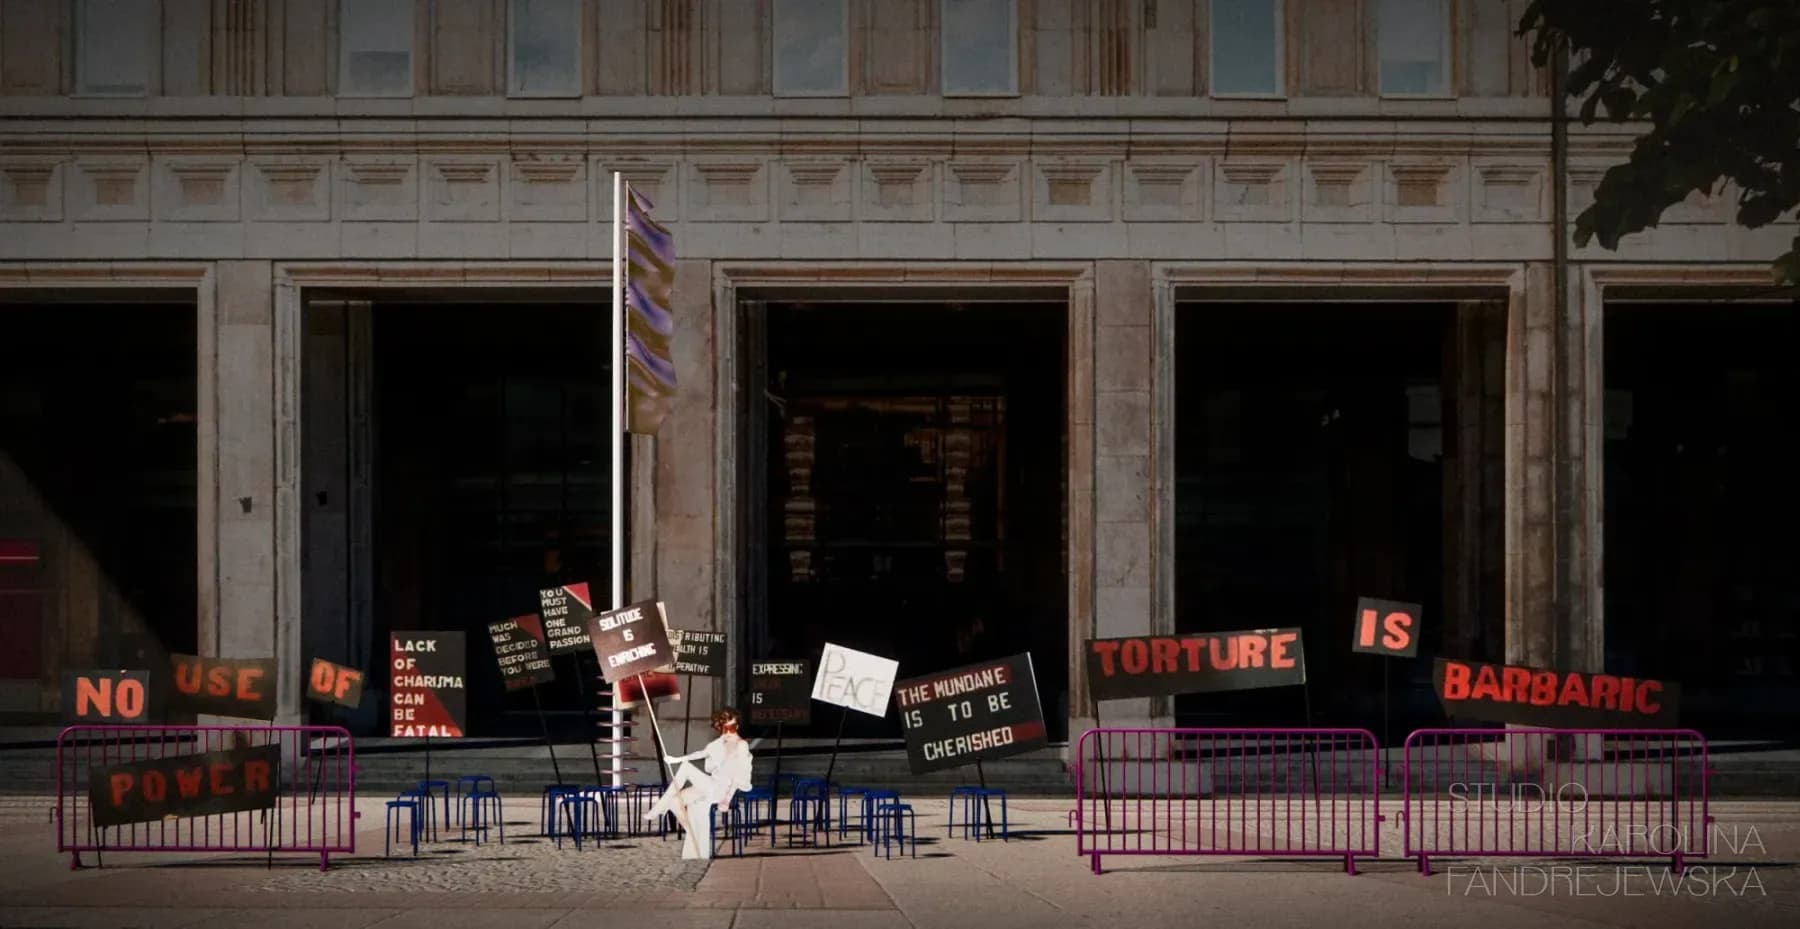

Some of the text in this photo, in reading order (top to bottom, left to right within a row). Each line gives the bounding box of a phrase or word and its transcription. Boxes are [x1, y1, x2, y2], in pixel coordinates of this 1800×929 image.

[540, 588, 563, 598] YOU
[541, 597, 567, 608] MUST
[543, 606, 568, 617] HAVE
[545, 618, 566, 628] ONE
[599, 608, 644, 631] SOLITUDE
[488, 621, 518, 634] MUCH
[547, 626, 581, 638] GRAND
[1359, 609, 1413, 650] IS
[492, 632, 511, 643] WAS
[622, 629, 634, 641] IS
[394, 640, 437, 652] LACK
[496, 640, 538, 654] DECIDED
[550, 635, 590, 649] PASSION
[698, 646, 709, 655] IS
[1093, 632, 1297, 677] TORTURE
[394, 658, 416, 670] OF
[498, 652, 538, 666] BEFORE
[501, 660, 551, 676] YOU WERE
[752, 663, 803, 675] EXPRESSING
[175, 662, 264, 701] USE
[311, 661, 360, 699] OF
[394, 675, 463, 688] CHARISMA
[819, 650, 888, 711] PEACE
[898, 667, 1006, 706] THE MUNDANE
[1444, 662, 1663, 714] BARBARIC
[76, 677, 145, 718] NO
[394, 692, 424, 705] CAN
[752, 692, 763, 704] IS
[394, 708, 415, 720] BE
[905, 692, 1012, 729] IS TO BE
[394, 725, 452, 737] FATAL
[923, 726, 1014, 761] CHERISHED
[111, 761, 271, 808] POWER
